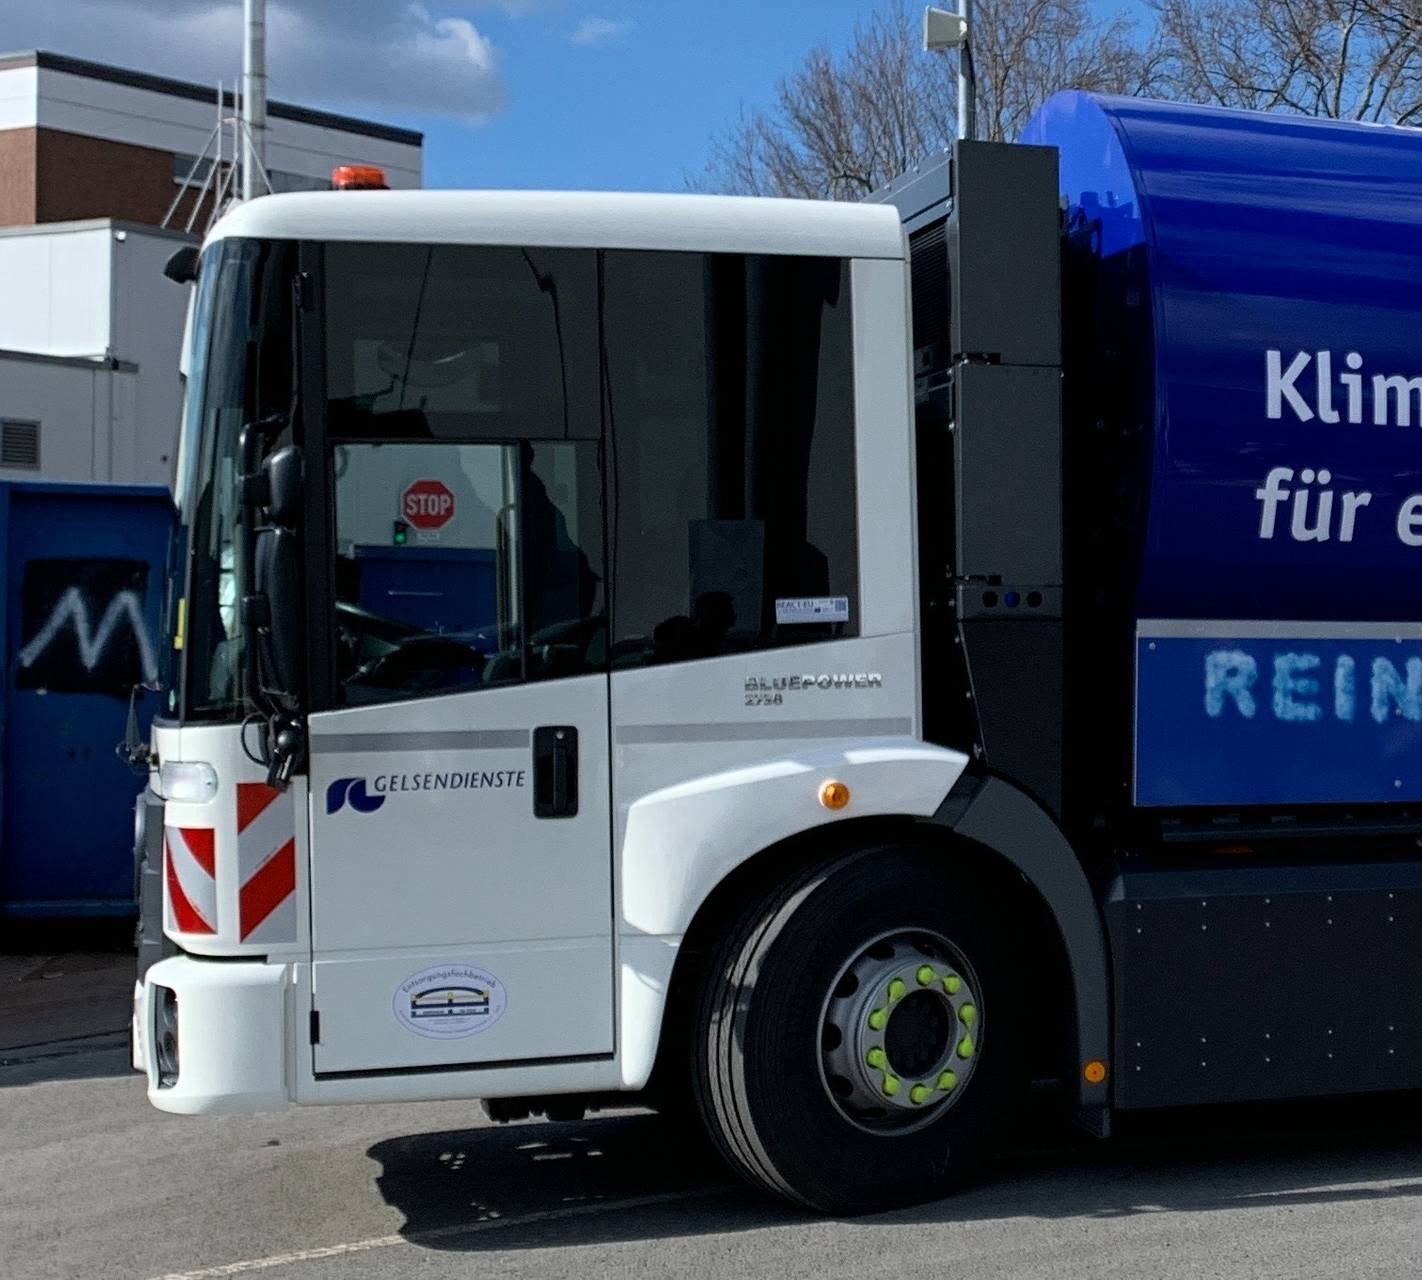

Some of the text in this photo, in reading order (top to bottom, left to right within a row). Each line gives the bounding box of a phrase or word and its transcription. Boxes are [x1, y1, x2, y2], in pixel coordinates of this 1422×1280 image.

[406, 494, 451, 516] STOP
[1256, 467, 1372, 542] für
[744, 672, 882, 691] BLUEPOWER
[374, 770, 526, 793] GELSENDIENSTE
